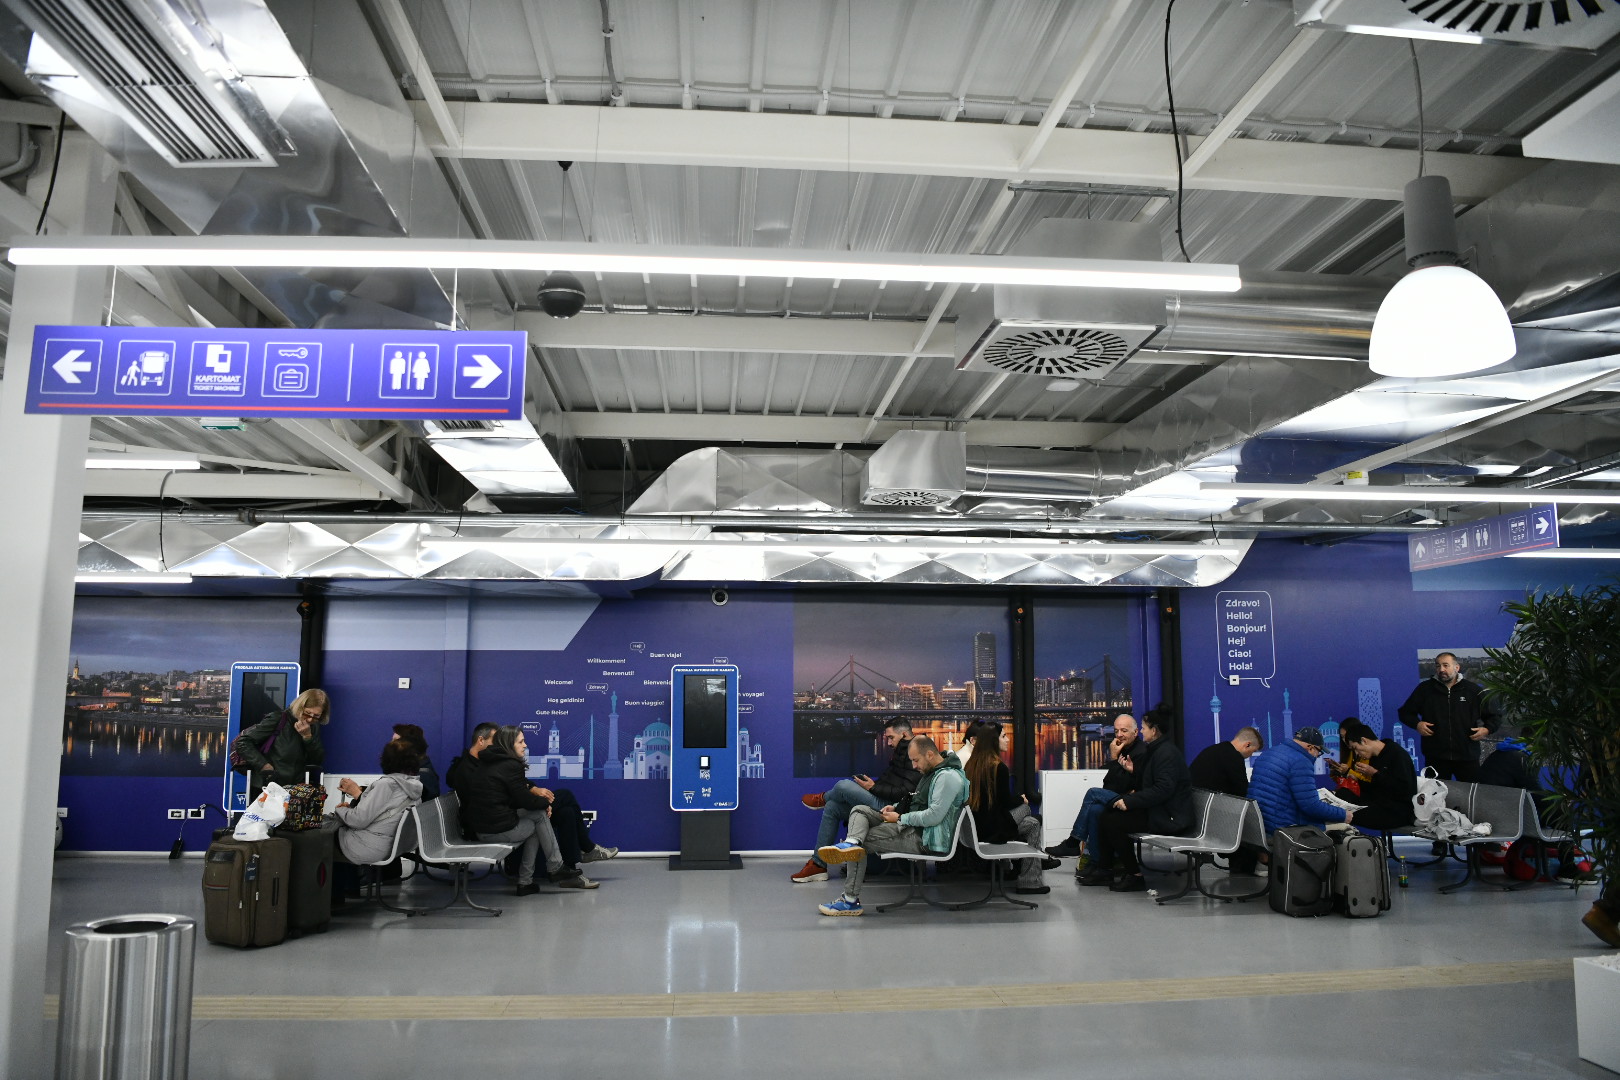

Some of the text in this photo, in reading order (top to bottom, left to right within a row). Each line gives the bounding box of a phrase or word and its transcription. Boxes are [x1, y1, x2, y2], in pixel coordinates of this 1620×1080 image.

[195, 375, 241, 383] KARTOMAT
[1226, 599, 1260, 607] Zdravo!
[1227, 624, 1266, 633] Bonjour!
[1228, 637, 1246, 646] Hej!
[1228, 649, 1252, 658] Ciao!
[1229, 662, 1252, 670] Hola!
